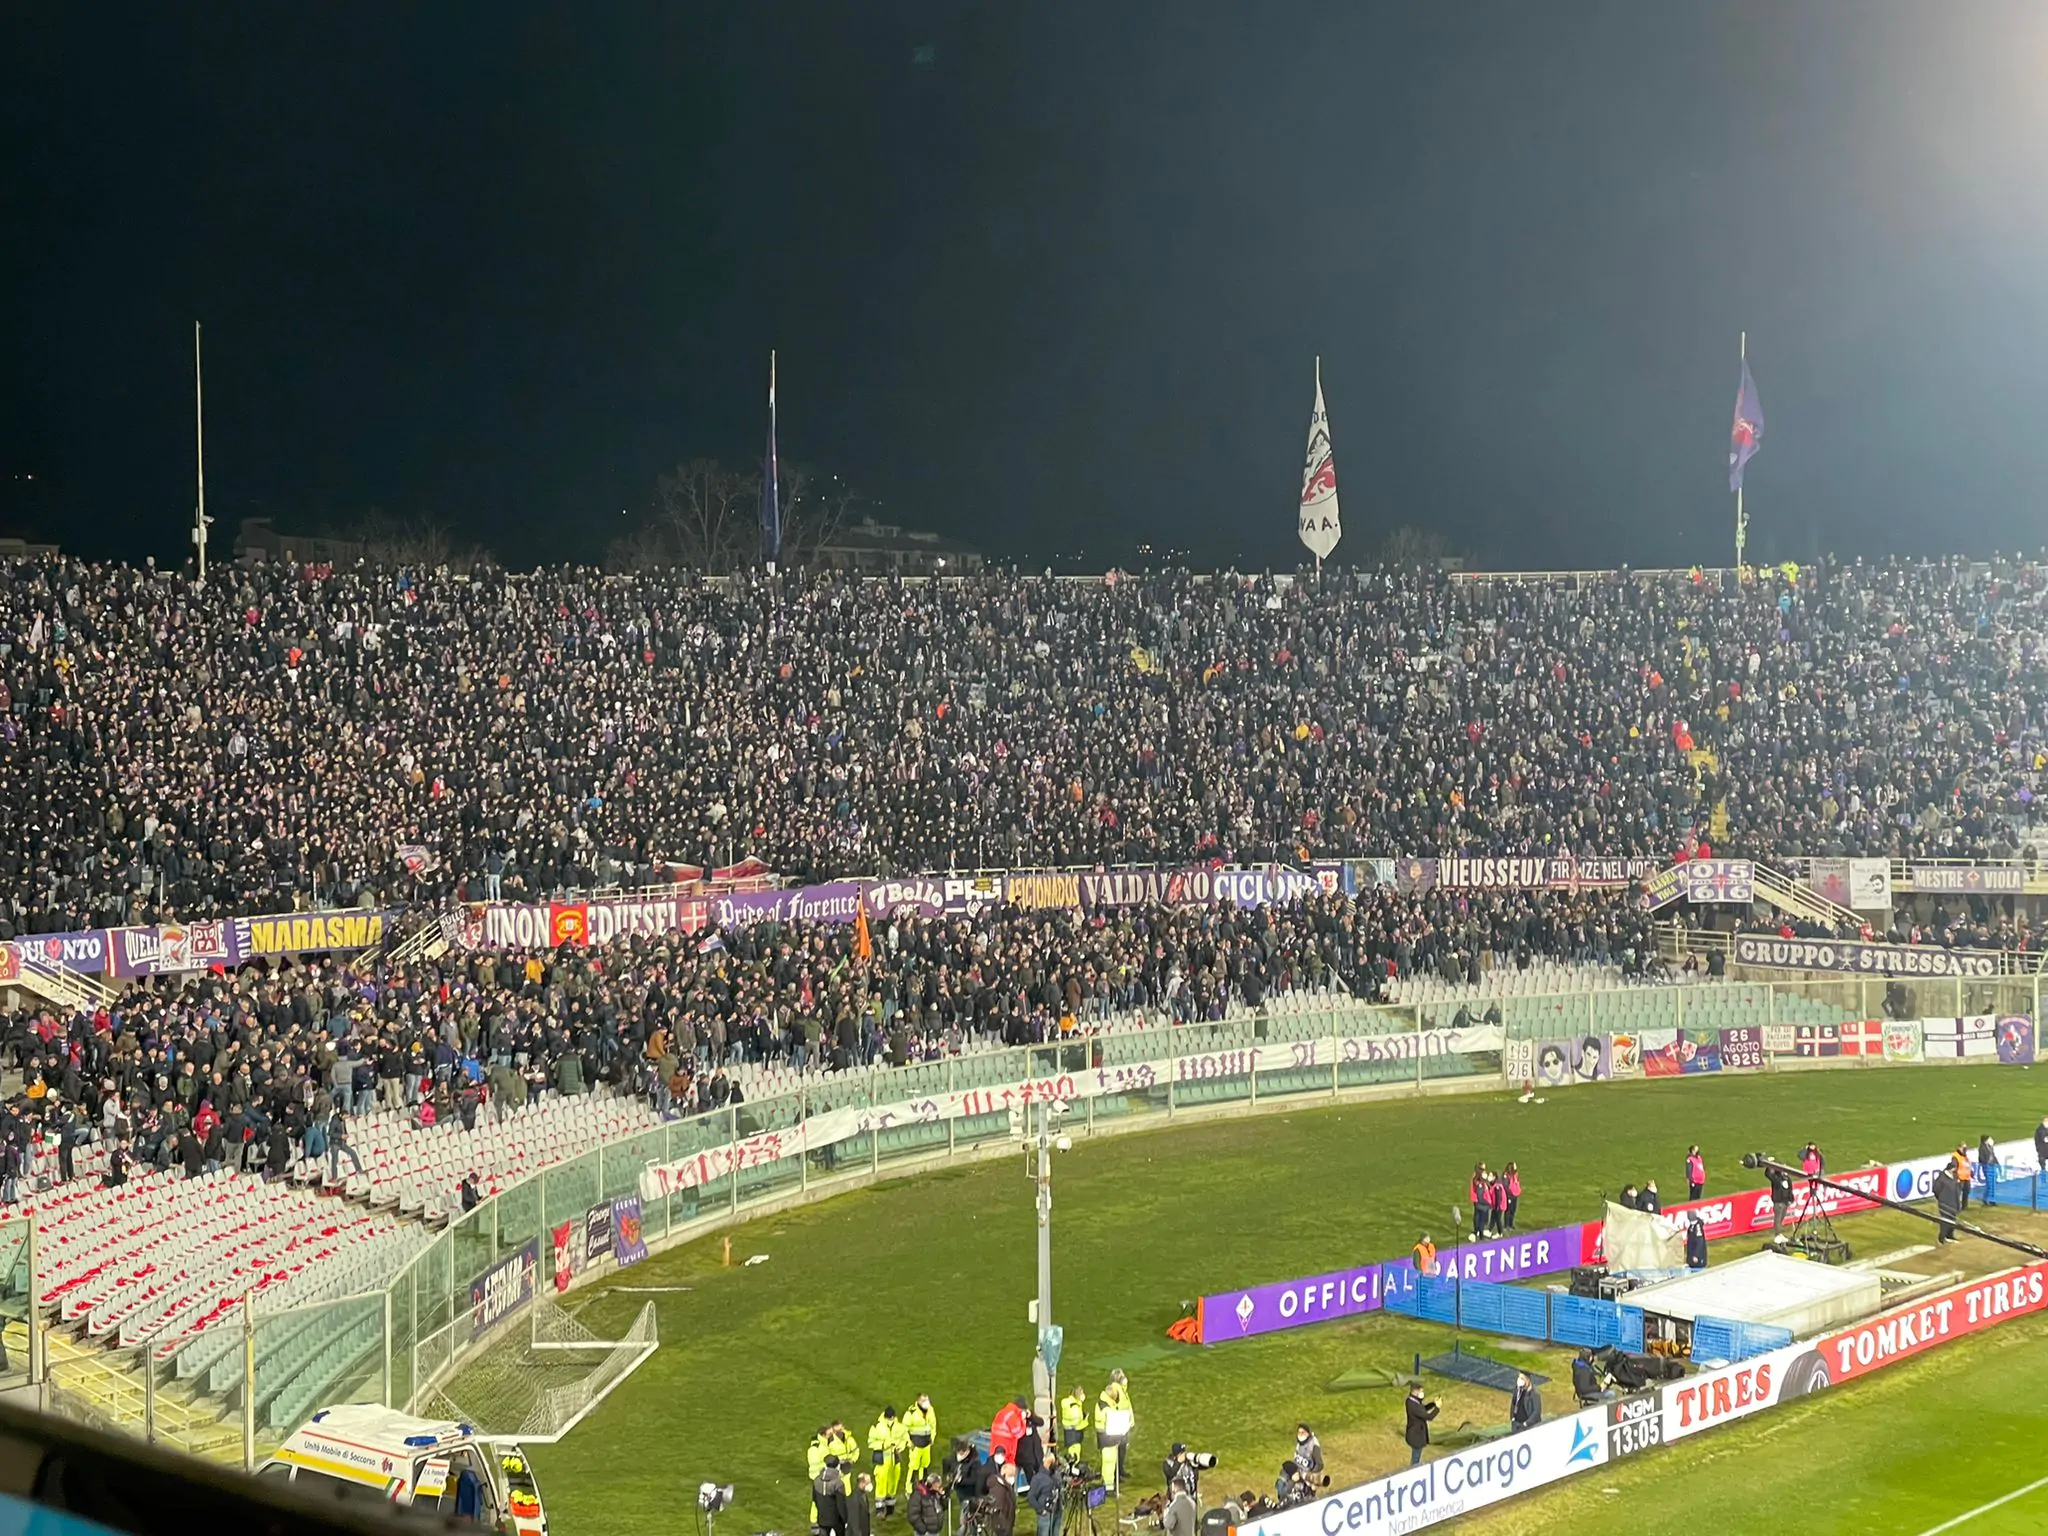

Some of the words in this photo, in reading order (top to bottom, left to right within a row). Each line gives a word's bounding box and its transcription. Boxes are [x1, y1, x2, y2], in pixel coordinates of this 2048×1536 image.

[1440, 858, 1545, 888] VIEUSSEUX
[1551, 860, 1600, 880] FIRNZE
[1602, 860, 1624, 880] NEL
[1915, 870, 1964, 889] MESTRE
[1984, 870, 2021, 888] VIOLA
[784, 892, 856, 921] Florence
[886, 881, 944, 908] Bello
[251, 915, 383, 953] MARASMA
[1740, 940, 1835, 967] GRUPPO
[1860, 949, 1994, 977] STRESSATO
[1723, 1041, 1761, 1053] AGOSTO
[1730, 1029, 1749, 1041] 26
[1279, 1268, 1413, 1318] OFFICIAL
[1836, 1301, 1954, 1374] TOMKET
[1966, 1271, 2044, 1324] TIRES
[1620, 1396, 1655, 1421] NGM
[1676, 1364, 1771, 1427] TIRES
[1613, 1416, 1660, 1457] 13:05
[320, 1446, 341, 1457] Mobile
[342, 1450, 348, 1459] di
[350, 1451, 376, 1466] Soccorso
[1322, 1462, 1435, 1536] Central
[1444, 1443, 1532, 1494] Cargo
[1388, 1514, 1418, 1536] North
[1420, 1500, 1464, 1525] America
